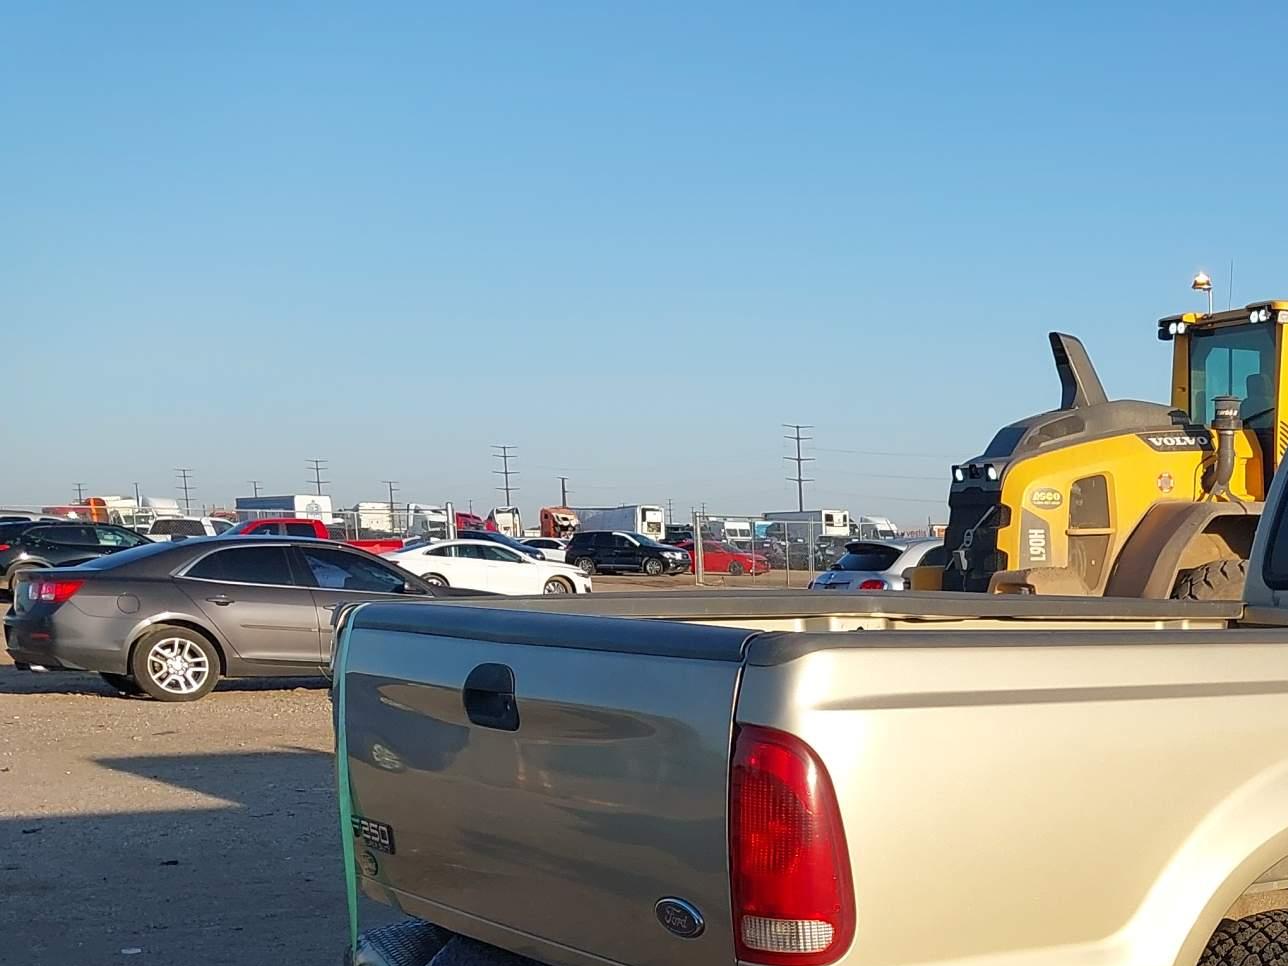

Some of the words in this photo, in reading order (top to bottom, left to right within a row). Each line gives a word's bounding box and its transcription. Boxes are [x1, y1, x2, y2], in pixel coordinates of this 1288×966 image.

[1147, 436, 1208, 446] VOLVO
[1032, 491, 1061, 501] ASCO
[1028, 528, 1046, 561] L90H
